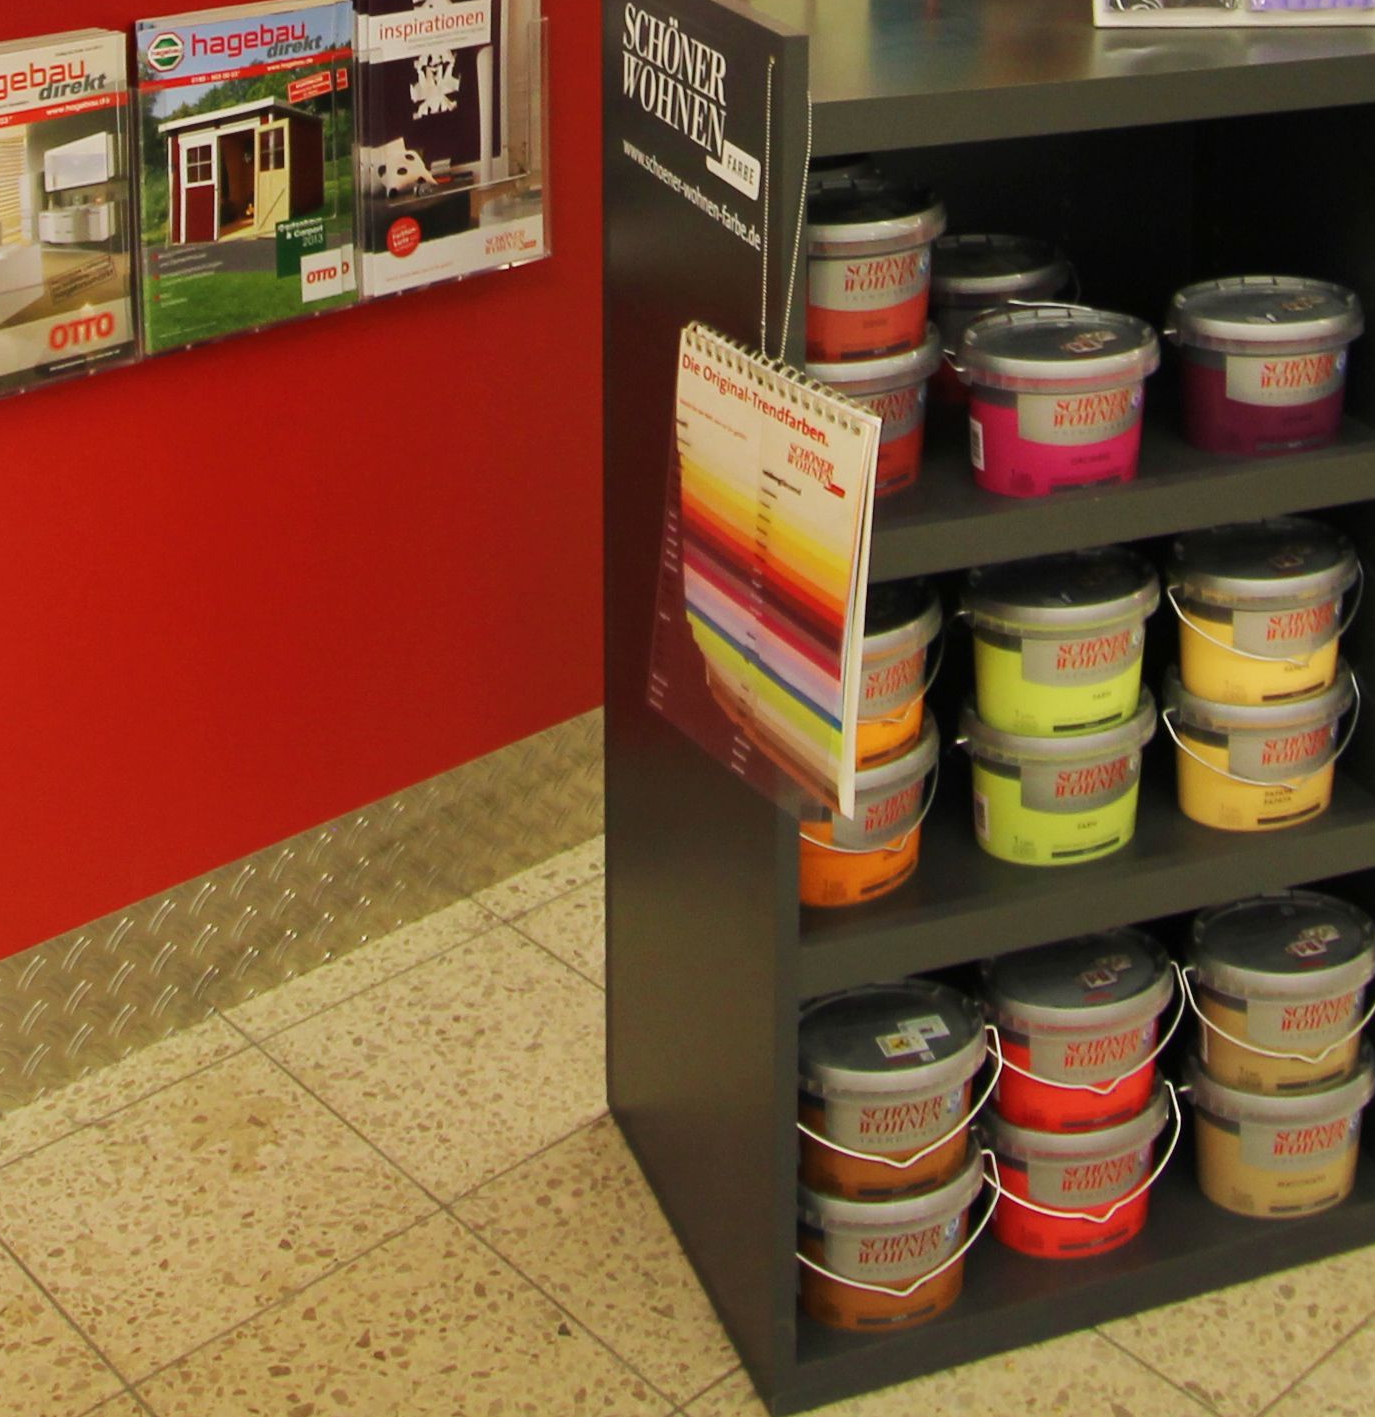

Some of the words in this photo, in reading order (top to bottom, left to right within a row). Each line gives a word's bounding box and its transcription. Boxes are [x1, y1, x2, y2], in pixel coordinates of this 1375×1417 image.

[192, 21, 305, 58] hagebau
[266, 35, 322, 58] direkt
[378, 9, 485, 41] inspirationen
[622, 1, 727, 107] SCHÖNER
[39, 72, 107, 101] direkt
[622, 50, 727, 160] WOHNEN
[726, 153, 756, 187] FARBE
[622, 138, 762, 252] www.schoener-wohnen-farbe.de
[307, 266, 337, 284] OTTO
[48, 311, 116, 351] OTTO
[680, 353, 701, 375] Die
[702, 362, 831, 449] Original-Trendfarben.
[786, 452, 835, 485] WOHNEN
[788, 441, 836, 473] SCHÖNER
